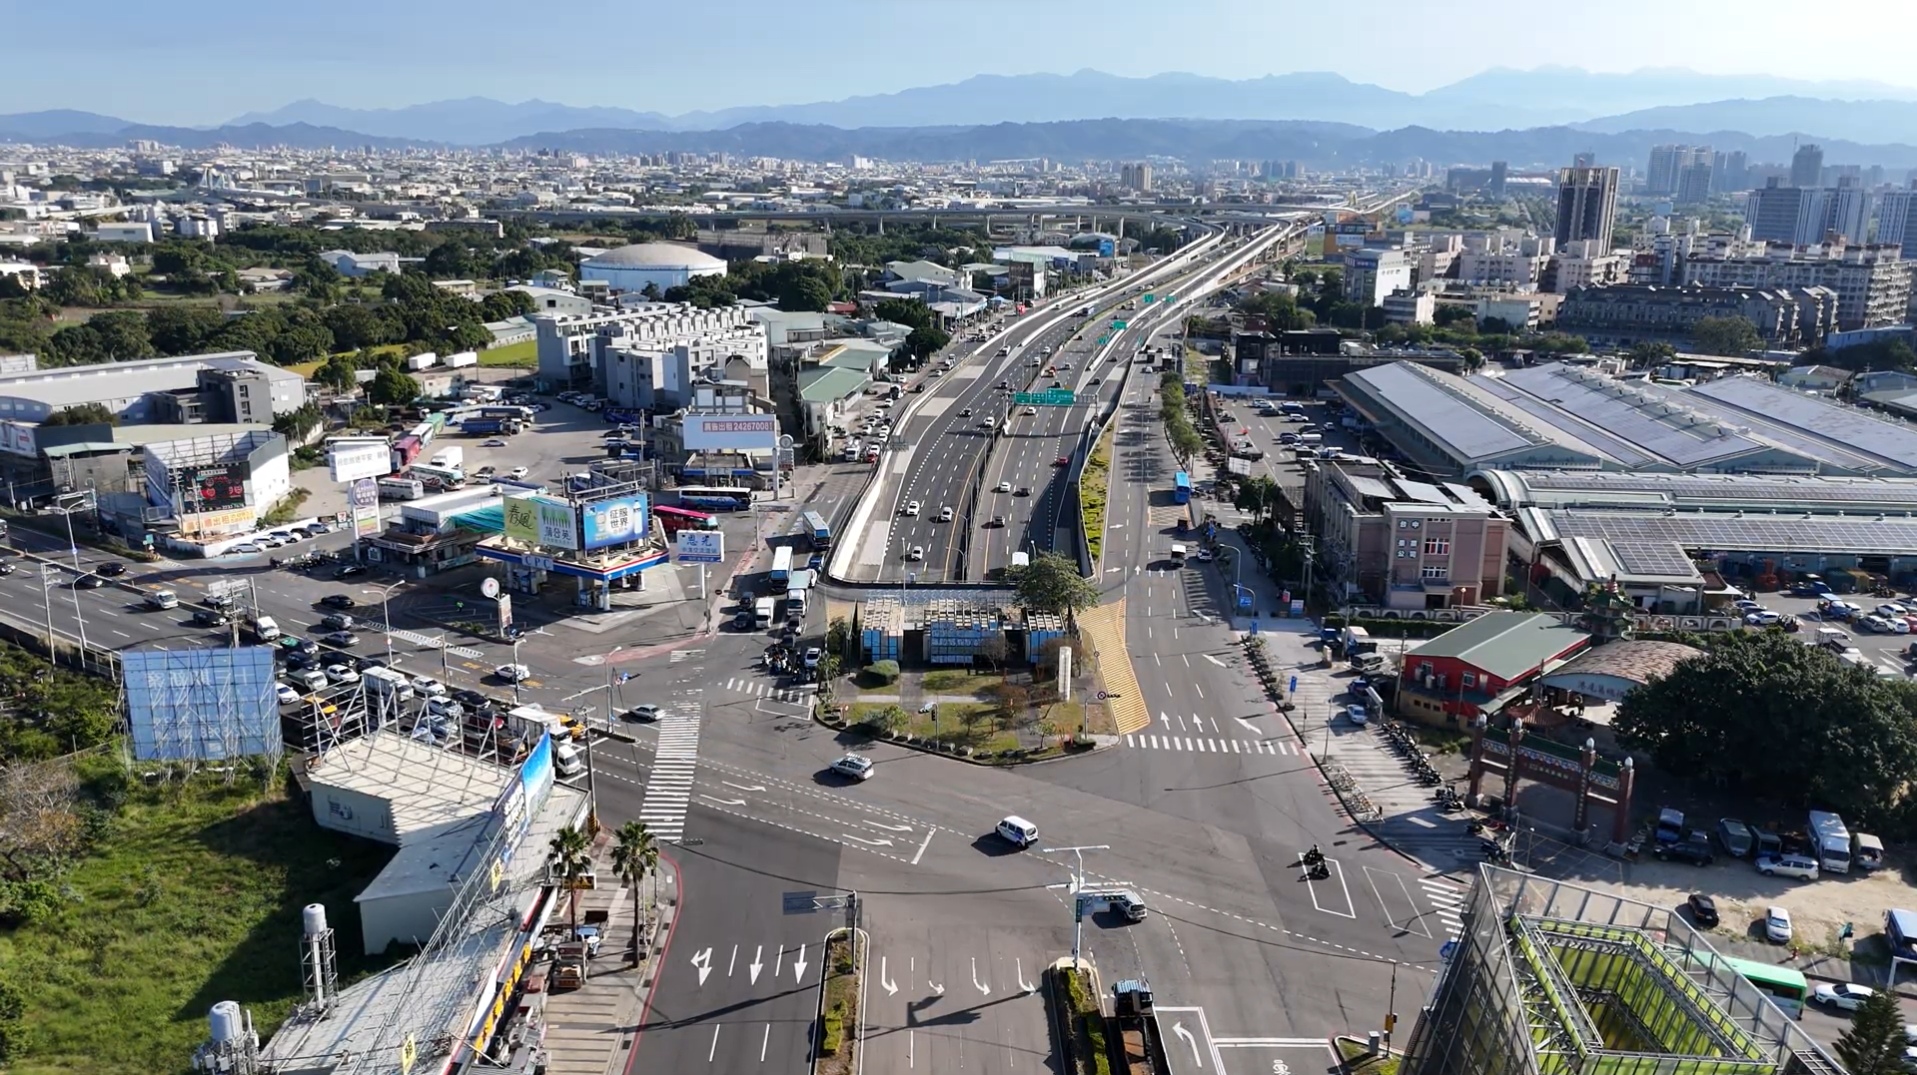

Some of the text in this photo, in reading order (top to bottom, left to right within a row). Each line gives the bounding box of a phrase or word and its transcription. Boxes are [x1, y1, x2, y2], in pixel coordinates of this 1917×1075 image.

[609, 507, 629, 518] 征服
[609, 517, 629, 529] 世界
[1399, 520, 1420, 529] 台中
[1397, 550, 1417, 558] 公司
[525, 555, 552, 569] CPC
